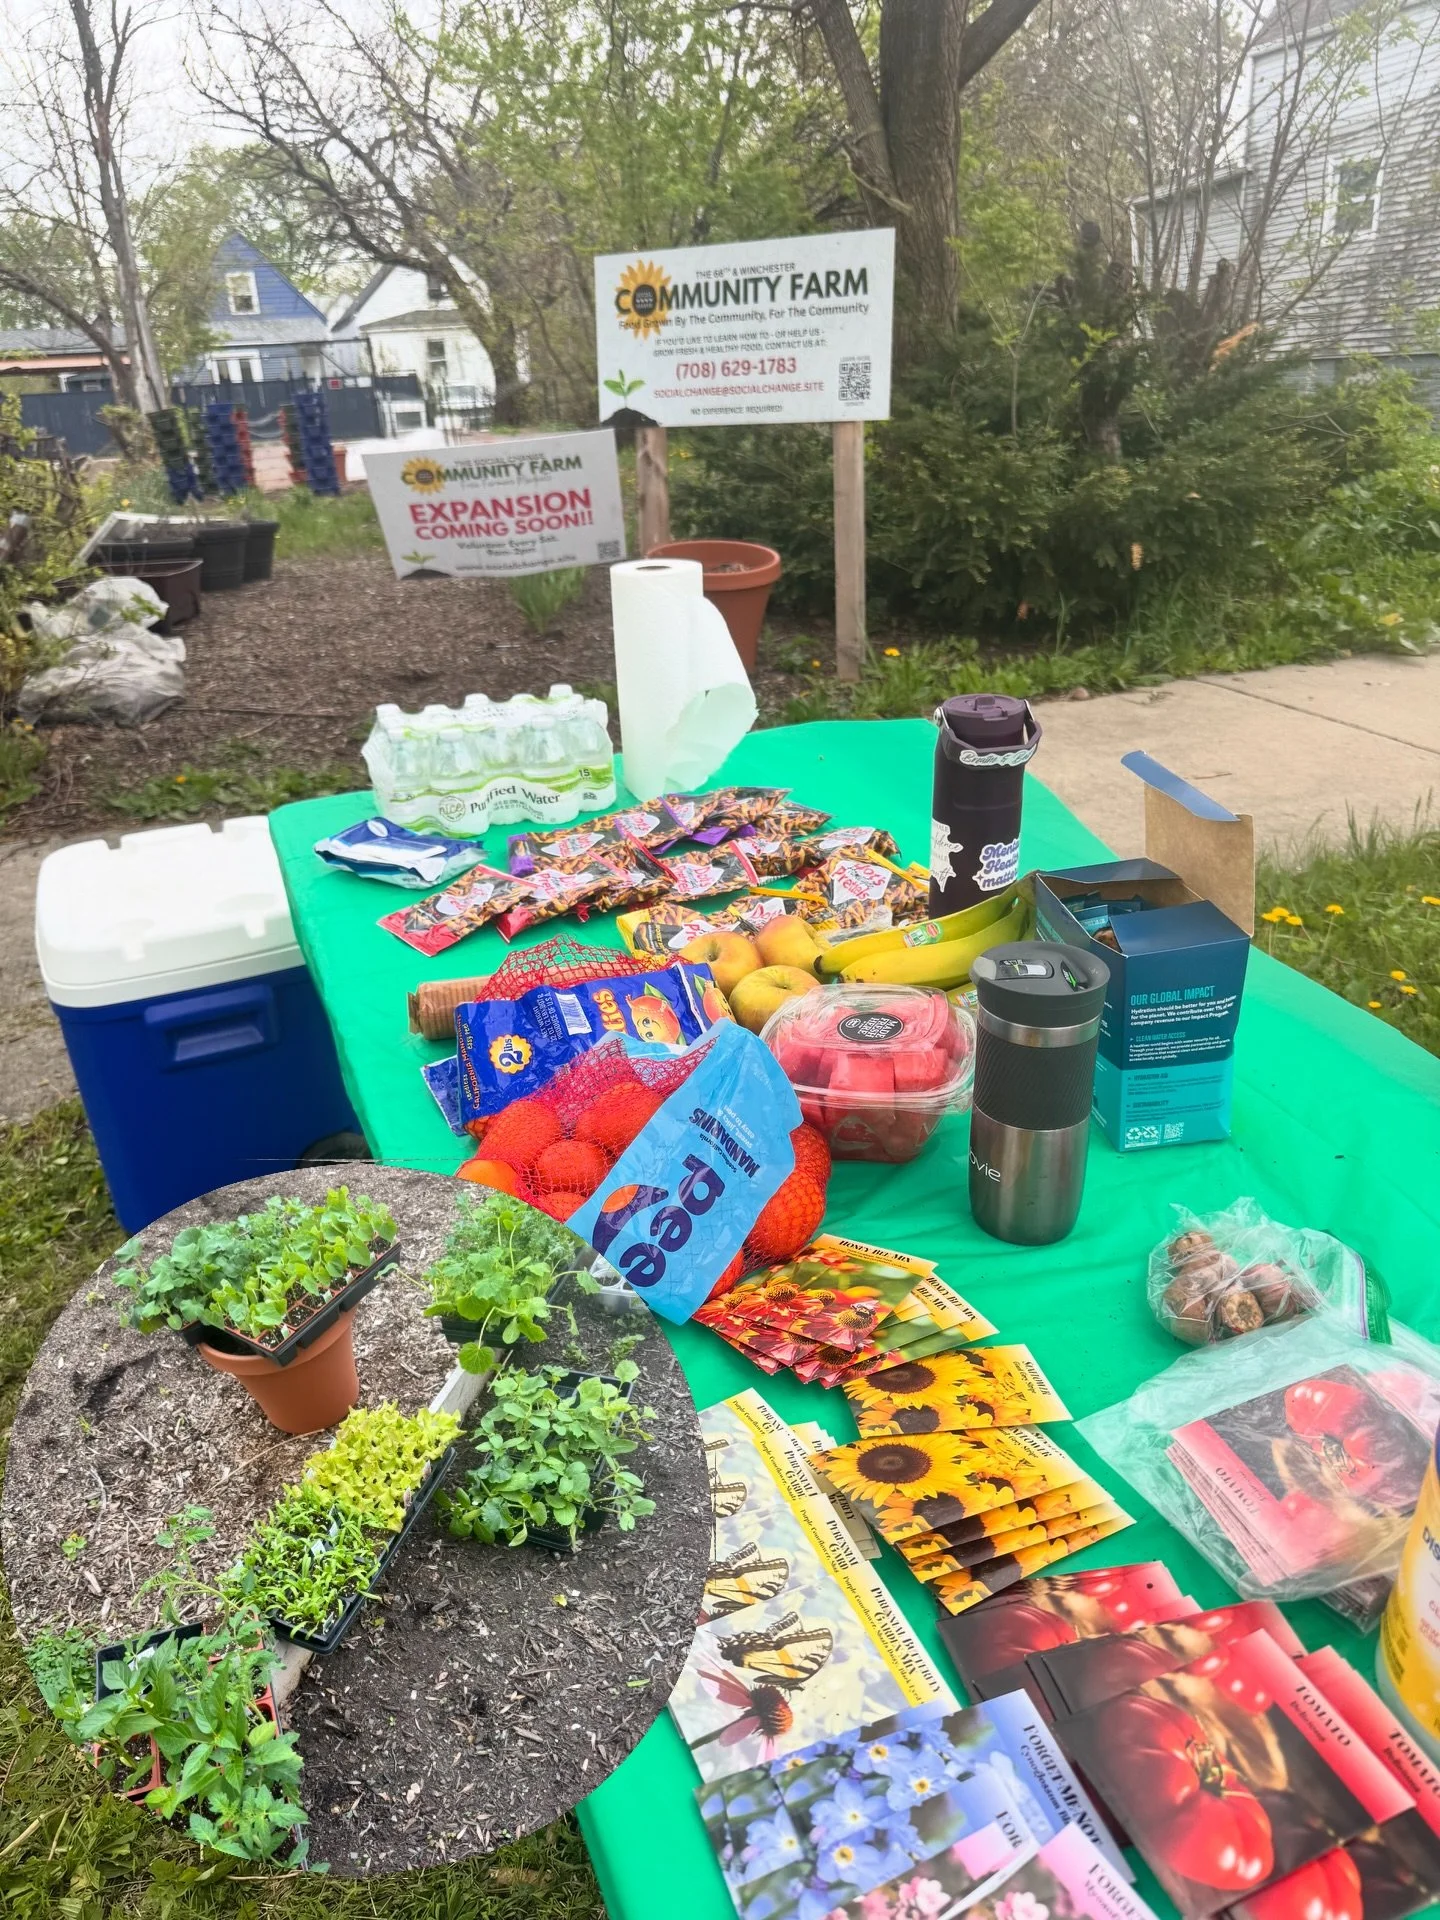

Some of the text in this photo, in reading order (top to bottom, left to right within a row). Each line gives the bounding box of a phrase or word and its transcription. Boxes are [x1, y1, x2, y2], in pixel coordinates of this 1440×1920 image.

[695, 269, 712, 280] THE
[739, 262, 795, 277] WINCHESTER
[614, 274, 782, 318] COMMUNITY
[790, 267, 869, 301] FARM
[618, 318, 642, 330] Food
[642, 318, 673, 329] Grown
[674, 316, 686, 329] By
[689, 314, 707, 326] The
[768, 309, 786, 320] For
[788, 306, 807, 317] The
[808, 302, 869, 317] Community
[705, 344, 740, 354] HEALTHY
[764, 340, 802, 351] CONTACT
[802, 339, 814, 349] US
[714, 333, 738, 344] LEARN
[739, 332, 758, 341] HOW
[787, 328, 808, 339] HELP
[808, 328, 821, 338] US
[675, 357, 798, 382] (708) 629-1783
[653, 381, 825, 399] SOCIALCHANGE@SOCIALCHANGE.SITE
[701, 405, 744, 416] EXPERIENCE
[401, 462, 524, 486] COMMUNITY
[529, 455, 583, 475] FARM
[409, 487, 592, 525] EXPANSION
[415, 509, 594, 541] COMING SOON!!
[578, 768, 591, 778] 15
[520, 786, 561, 806] Water
[1130, 985, 1216, 1006] OUR GLOBAL IMPACT
[1130, 1006, 1157, 1015] Hydration
[1157, 1005, 1174, 1014] should
[1206, 1000, 1216, 1008] you
[857, 1016, 881, 1036] HERE
[1130, 1019, 1154, 1027] company
[1191, 1013, 1209, 1021] Impact
[1149, 1012, 1166, 1020] planet.
[1177, 1008, 1203, 1016] contribute
[865, 1017, 890, 1039] FRESH
[874, 1019, 899, 1039] MADE
[1135, 1034, 1151, 1042] CLEAN
[1168, 1031, 1186, 1040] ACCESS
[498, 1038, 524, 1068] 2 lbs
[466, 1060, 481, 1110] CALIFORNIA
[688, 1107, 761, 1179] MANDARINS
[838, 1239, 871, 1254] HONEY
[871, 1248, 890, 1258] BEE
[893, 1252, 914, 1264] MIX
[915, 1286, 949, 1312] BEE MIX
[925, 1276, 979, 1323] HONEY BEE MIX
[732, 1399, 746, 1414] Purple
[759, 1440, 773, 1456] Purple
[785, 1470, 807, 1500] GARDE
[1216, 1466, 1260, 1515] TOMATO
[799, 1508, 813, 1527] Purple
[825, 1519, 859, 1567] PERENNIAL
[828, 1542, 850, 1571] GARD
[842, 1574, 857, 1596] Purple
[870, 1586, 941, 1694] PERENNIAL BUTTERFLY
[873, 1610, 918, 1676] GARDEN MIX
[1295, 1685, 1352, 1747] TOMATO
[1019, 1744, 1060, 1811] Cynoglossum
